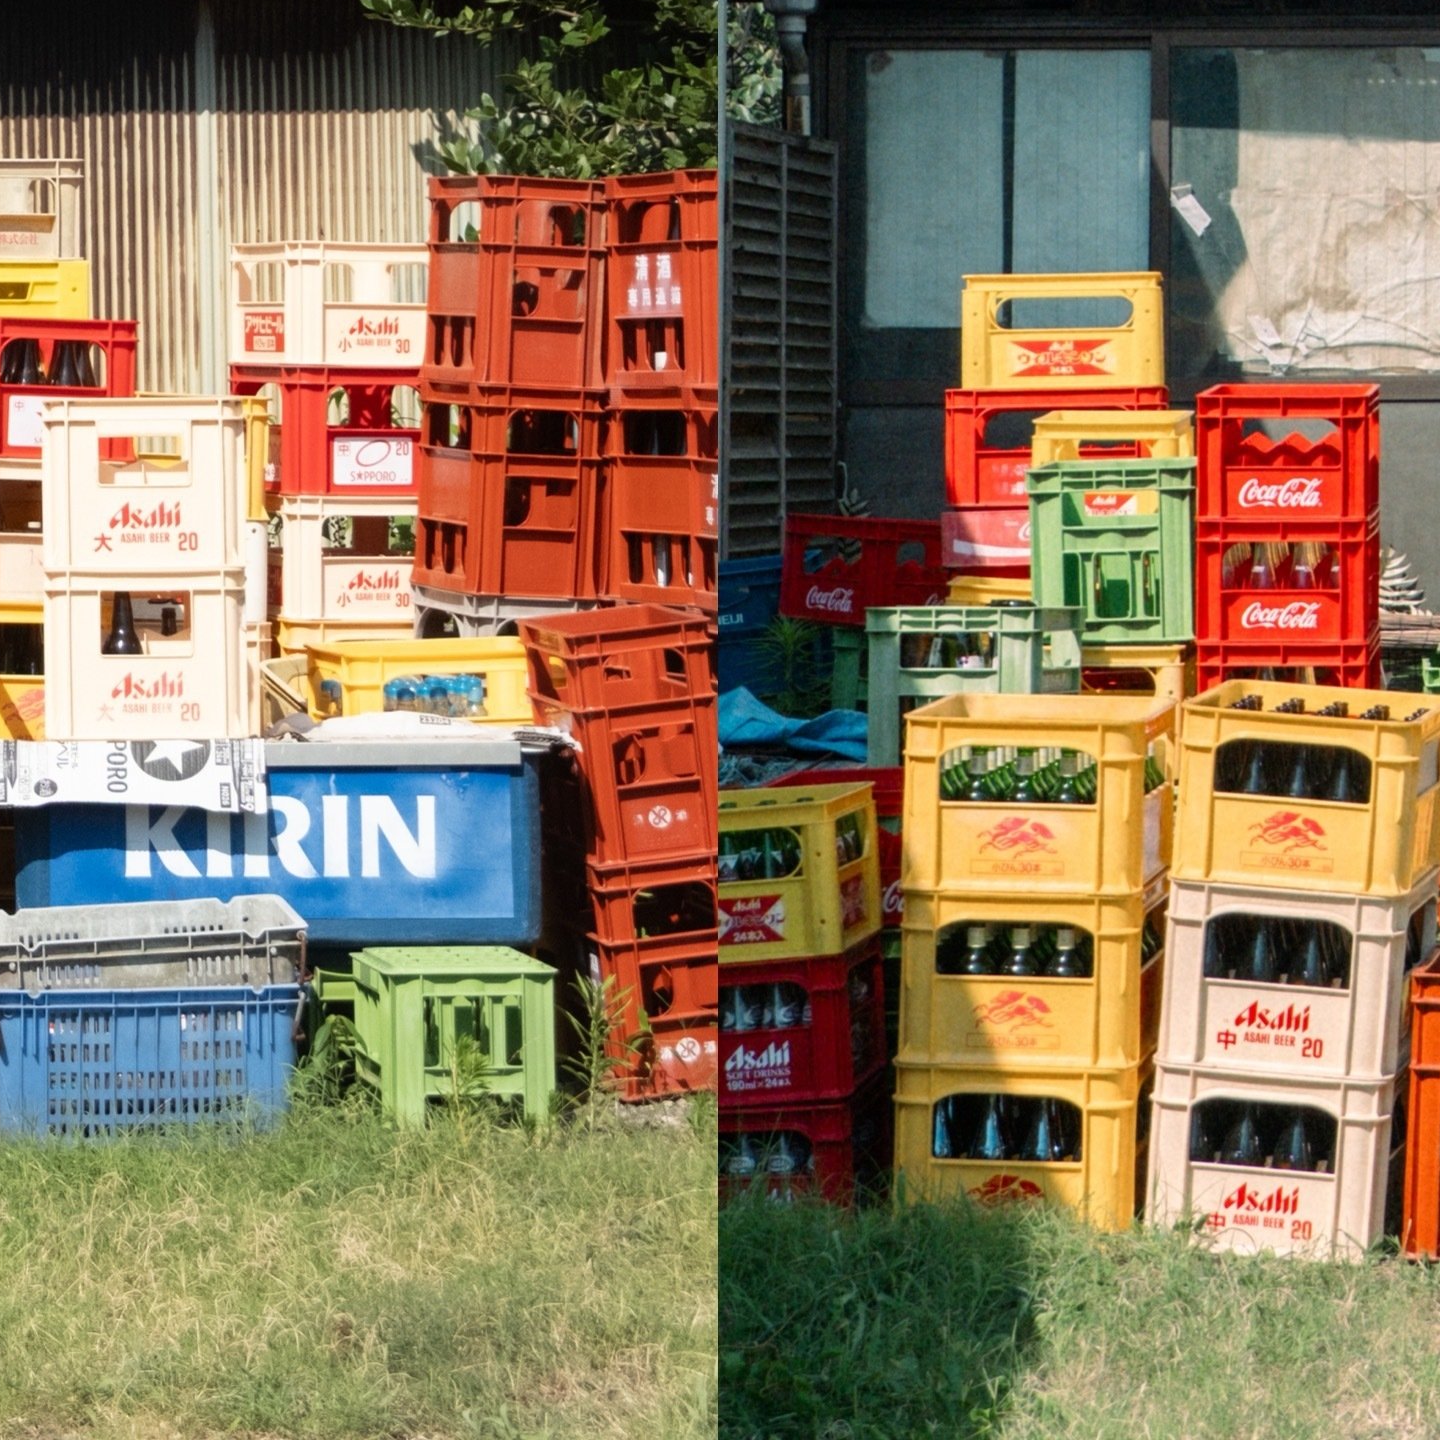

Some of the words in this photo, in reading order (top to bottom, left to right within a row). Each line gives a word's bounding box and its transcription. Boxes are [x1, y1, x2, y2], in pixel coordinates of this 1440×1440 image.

[349, 316, 399, 335] Asahi
[339, 337, 352, 353] 小
[396, 339, 410, 353] 30
[396, 441, 409, 456] 20
[1239, 479, 1321, 507] Coca-Cola
[109, 501, 180, 529] Asahi
[93, 532, 113, 552] 大
[120, 533, 145, 543] ASAHI
[150, 533, 170, 543] BEER
[178, 532, 198, 551] 20
[348, 570, 399, 589] Asahi
[336, 591, 351, 607] 小
[395, 592, 410, 607] 30
[807, 585, 853, 611] Coca-Cola
[1242, 602, 1320, 628] Coca-Cola
[111, 671, 183, 699] Asahi
[180, 702, 200, 721] 20
[125, 795, 436, 878] KIRIN
[1234, 1000, 1310, 1032] Asahi
[1216, 1029, 1237, 1051] 中
[1244, 1031, 1270, 1044] ASAHI
[1274, 1034, 1296, 1047] BEER
[1301, 1037, 1323, 1058] 20
[727, 1041, 791, 1070] Asahi
[1224, 1182, 1299, 1214] Asahi
[1233, 1213, 1260, 1226] ASAHI
[1264, 1216, 1285, 1229] BEER
[1291, 1219, 1313, 1240] 20
